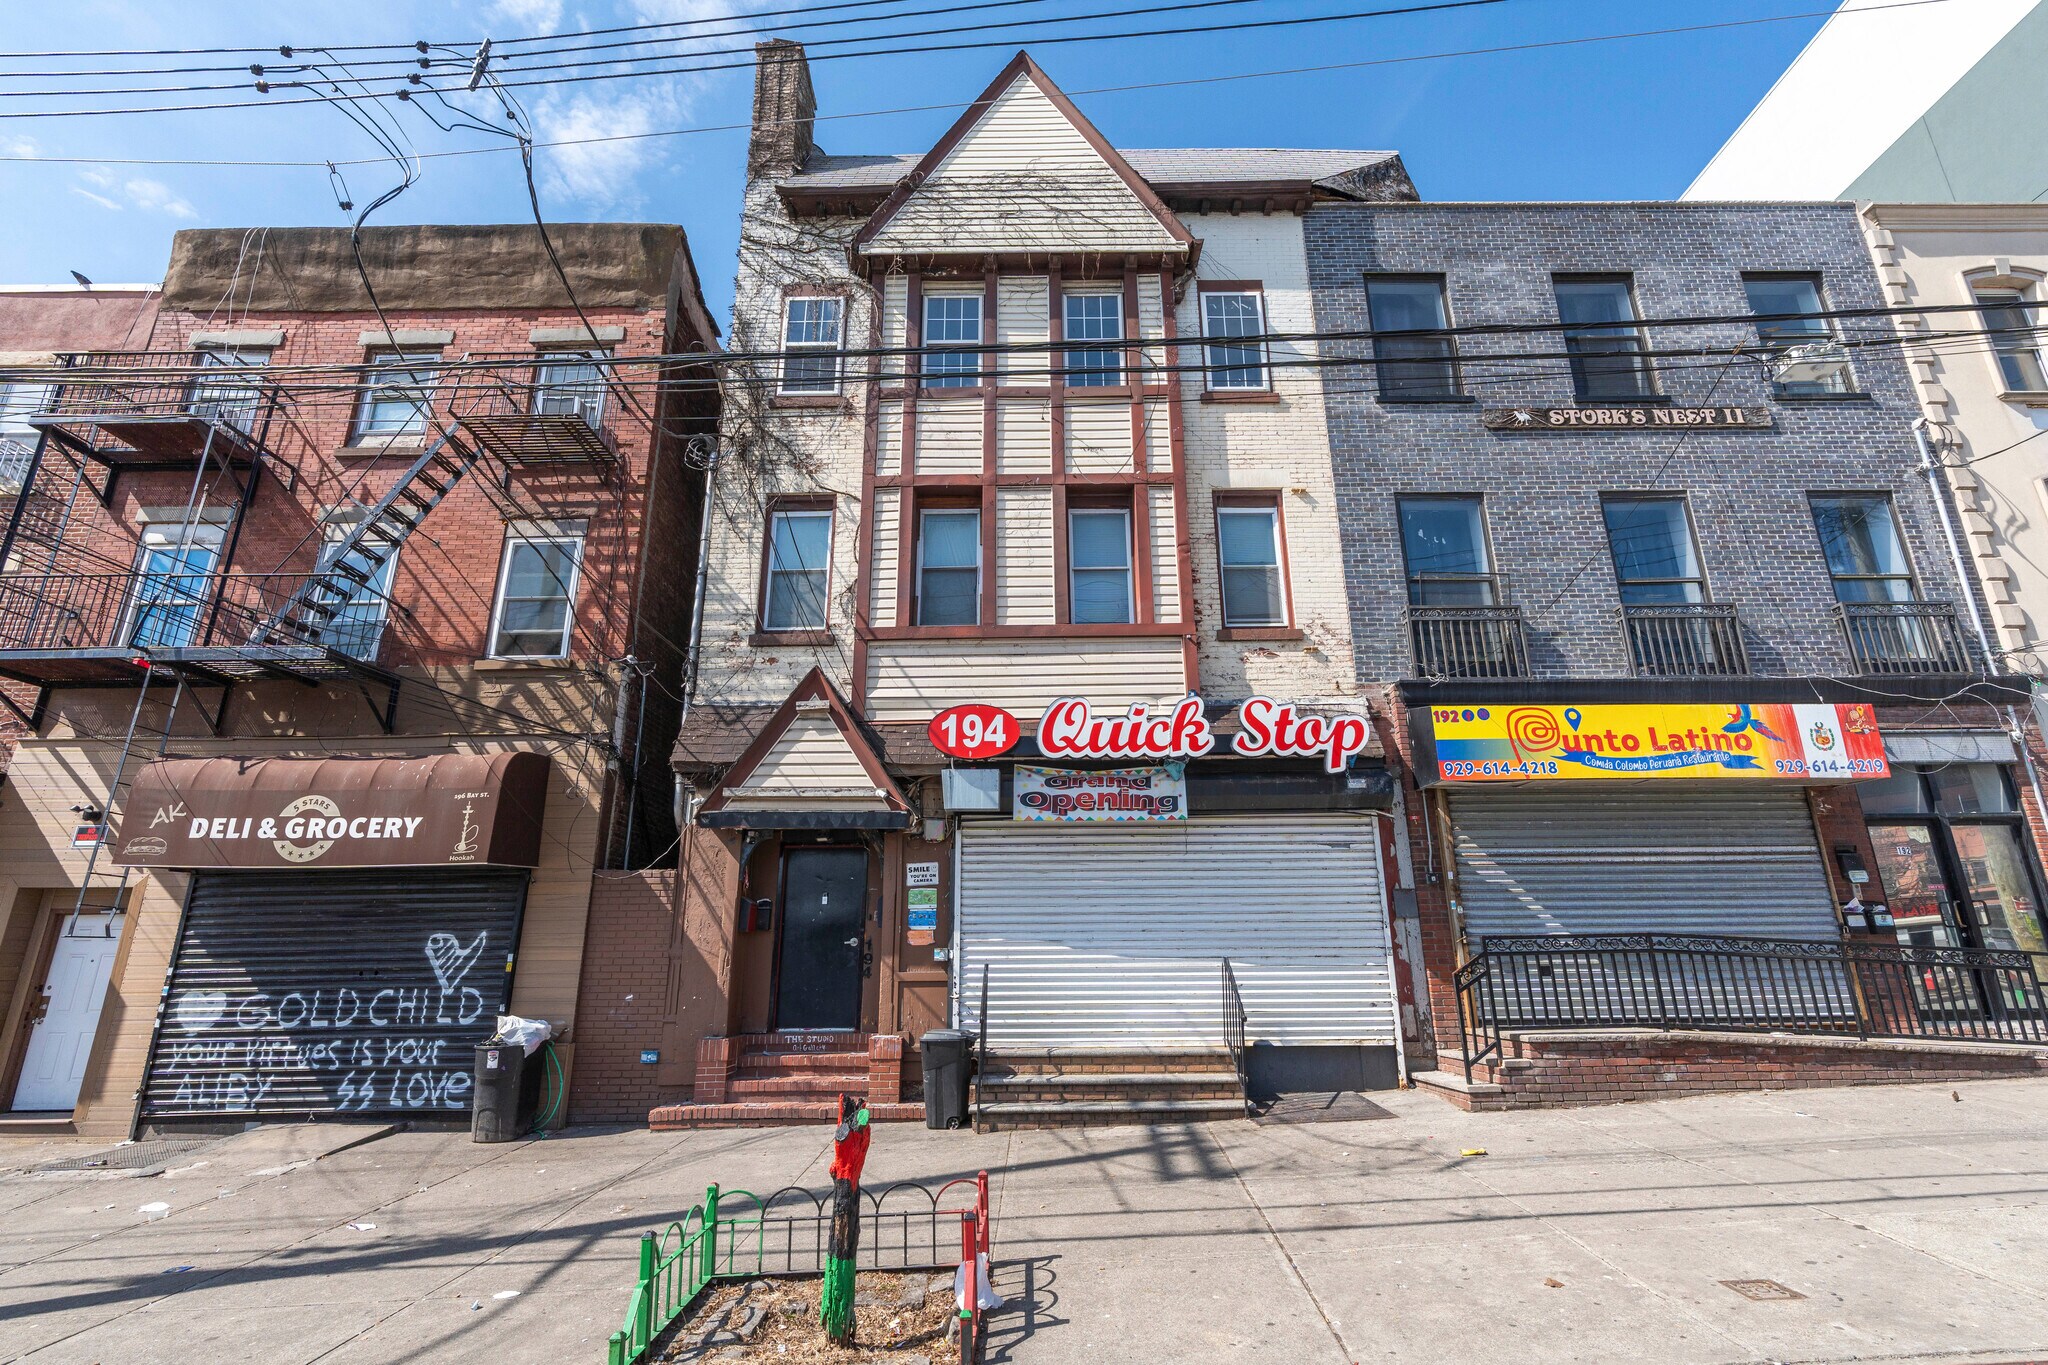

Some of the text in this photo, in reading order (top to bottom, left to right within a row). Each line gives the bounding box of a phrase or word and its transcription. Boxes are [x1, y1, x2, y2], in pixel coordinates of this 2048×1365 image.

[1549, 409, 1647, 425] STORK'S
[1653, 408, 1716, 425] NEST
[1433, 710, 1460, 723] 192
[941, 713, 1007, 749] 194
[1040, 699, 1365, 769] Quick Stop
[1648, 726, 1753, 752] Latino
[1443, 761, 1559, 776] 929-614-4218
[1585, 755, 1614, 769] Comida
[1615, 760, 1649, 771] Colombo
[1775, 759, 1884, 773] 929-614-4219
[1044, 776, 1152, 790] Grand
[293, 798, 331, 813] 5 STARS
[1019, 788, 1179, 816] Opening
[149, 801, 187, 829] AK
[188, 816, 424, 839] DELI & GROCERY
[1896, 846, 1912, 855] 192
[784, 1034, 835, 1044] THE STUDIO
